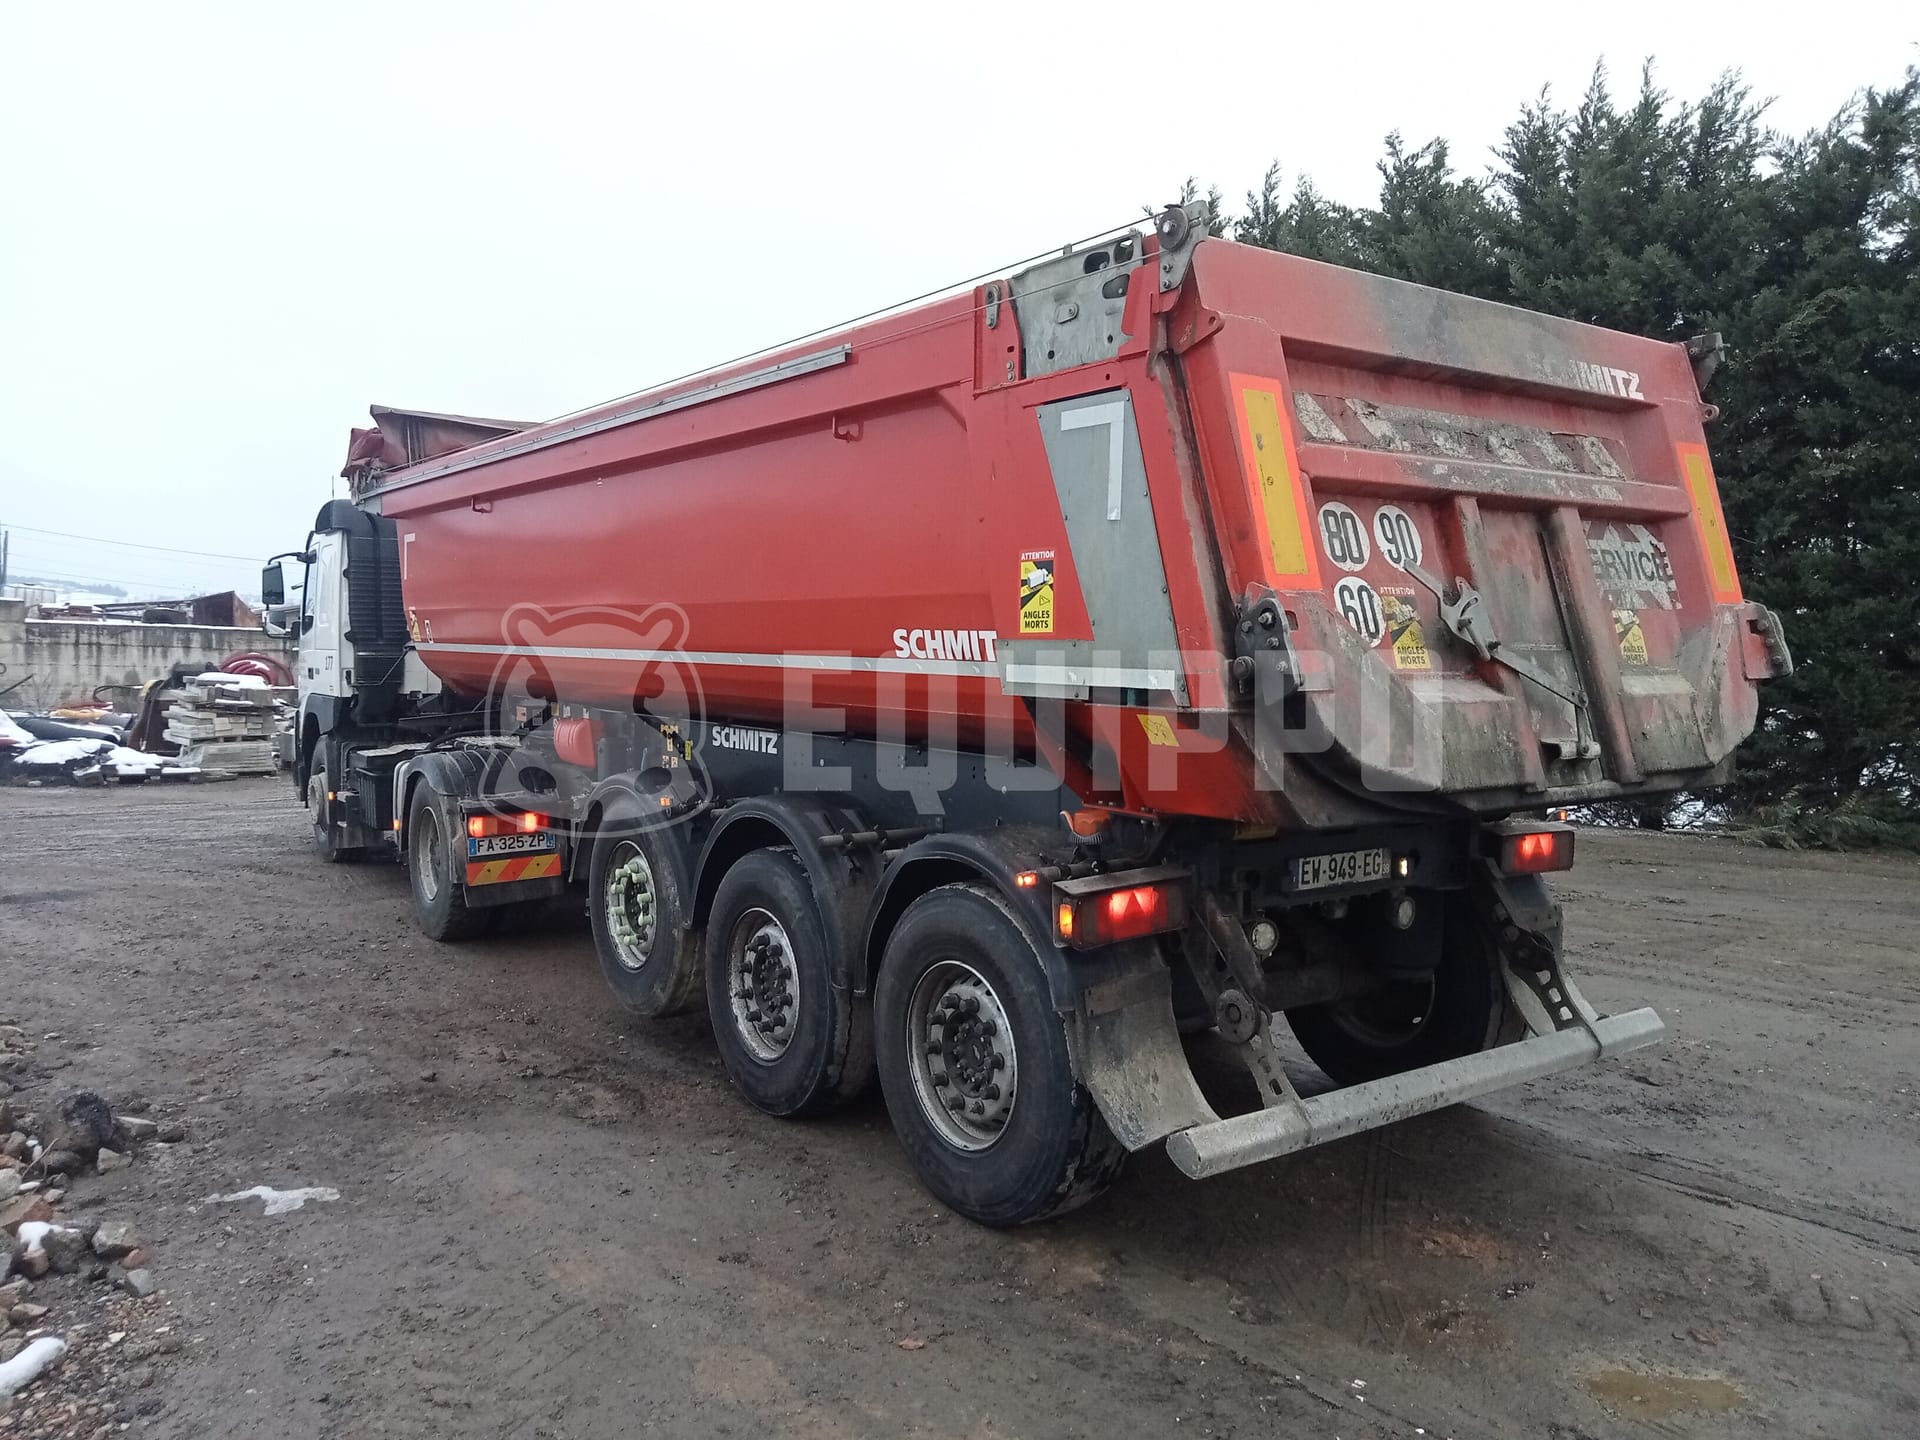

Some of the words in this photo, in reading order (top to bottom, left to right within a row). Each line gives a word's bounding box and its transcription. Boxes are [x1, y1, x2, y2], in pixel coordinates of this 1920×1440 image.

[1322, 509, 1364, 565] 80
[1379, 512, 1418, 565] 90
[1021, 550, 1055, 560] ATTENTION
[1589, 547, 1674, 582] ERVICE
[1380, 586, 1416, 596] ATTENTION
[1023, 610, 1050, 619] ANGLES
[1339, 584, 1380, 640] 60
[1024, 620, 1049, 629] MORTS
[893, 628, 998, 662] SCHMIT
[1397, 645, 1426, 655] ANGLES
[1399, 655, 1426, 665] MORTS
[712, 725, 778, 755] SCHMITZ
[477, 834, 546, 853] FA-325-ZP
[1301, 852, 1381, 885] EW-949-EG
